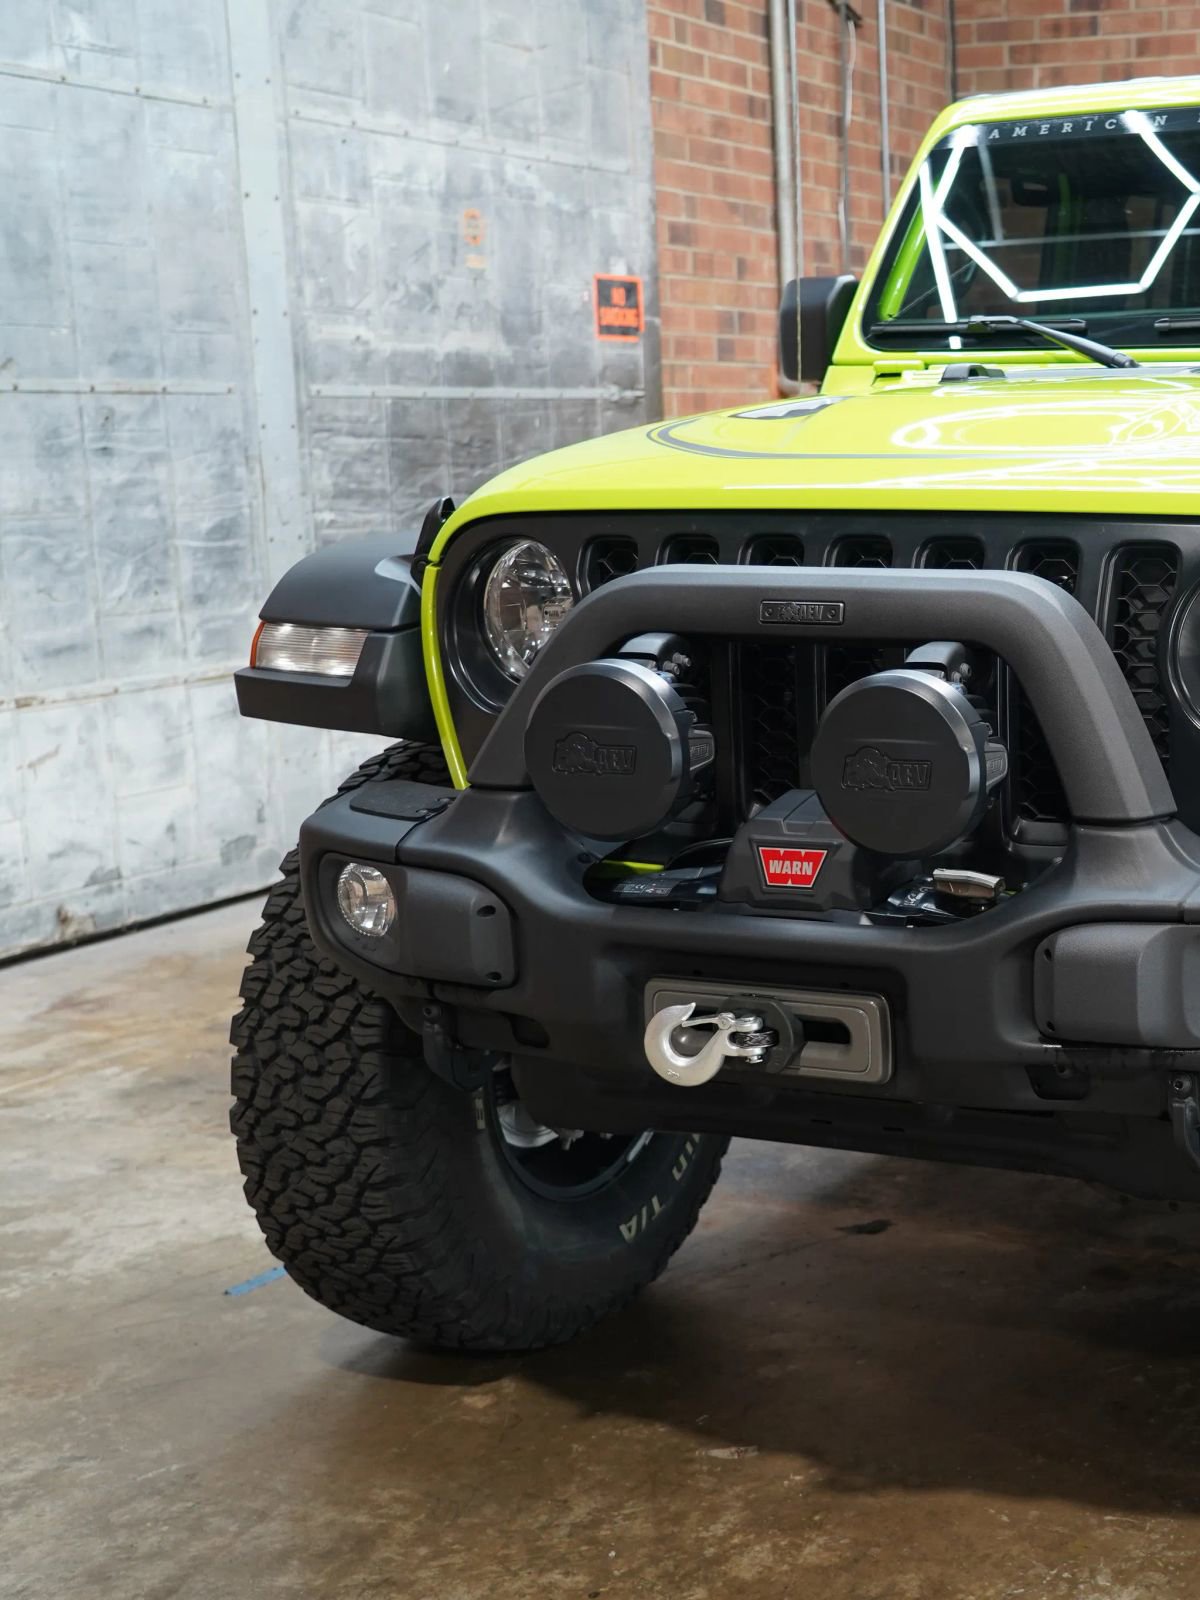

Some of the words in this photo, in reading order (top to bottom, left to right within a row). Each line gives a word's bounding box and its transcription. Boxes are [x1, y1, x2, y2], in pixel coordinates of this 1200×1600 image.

[988, 115, 1168, 139] AMERICN
[769, 859, 814, 876] WARN
[619, 1194, 669, 1243] T/A
